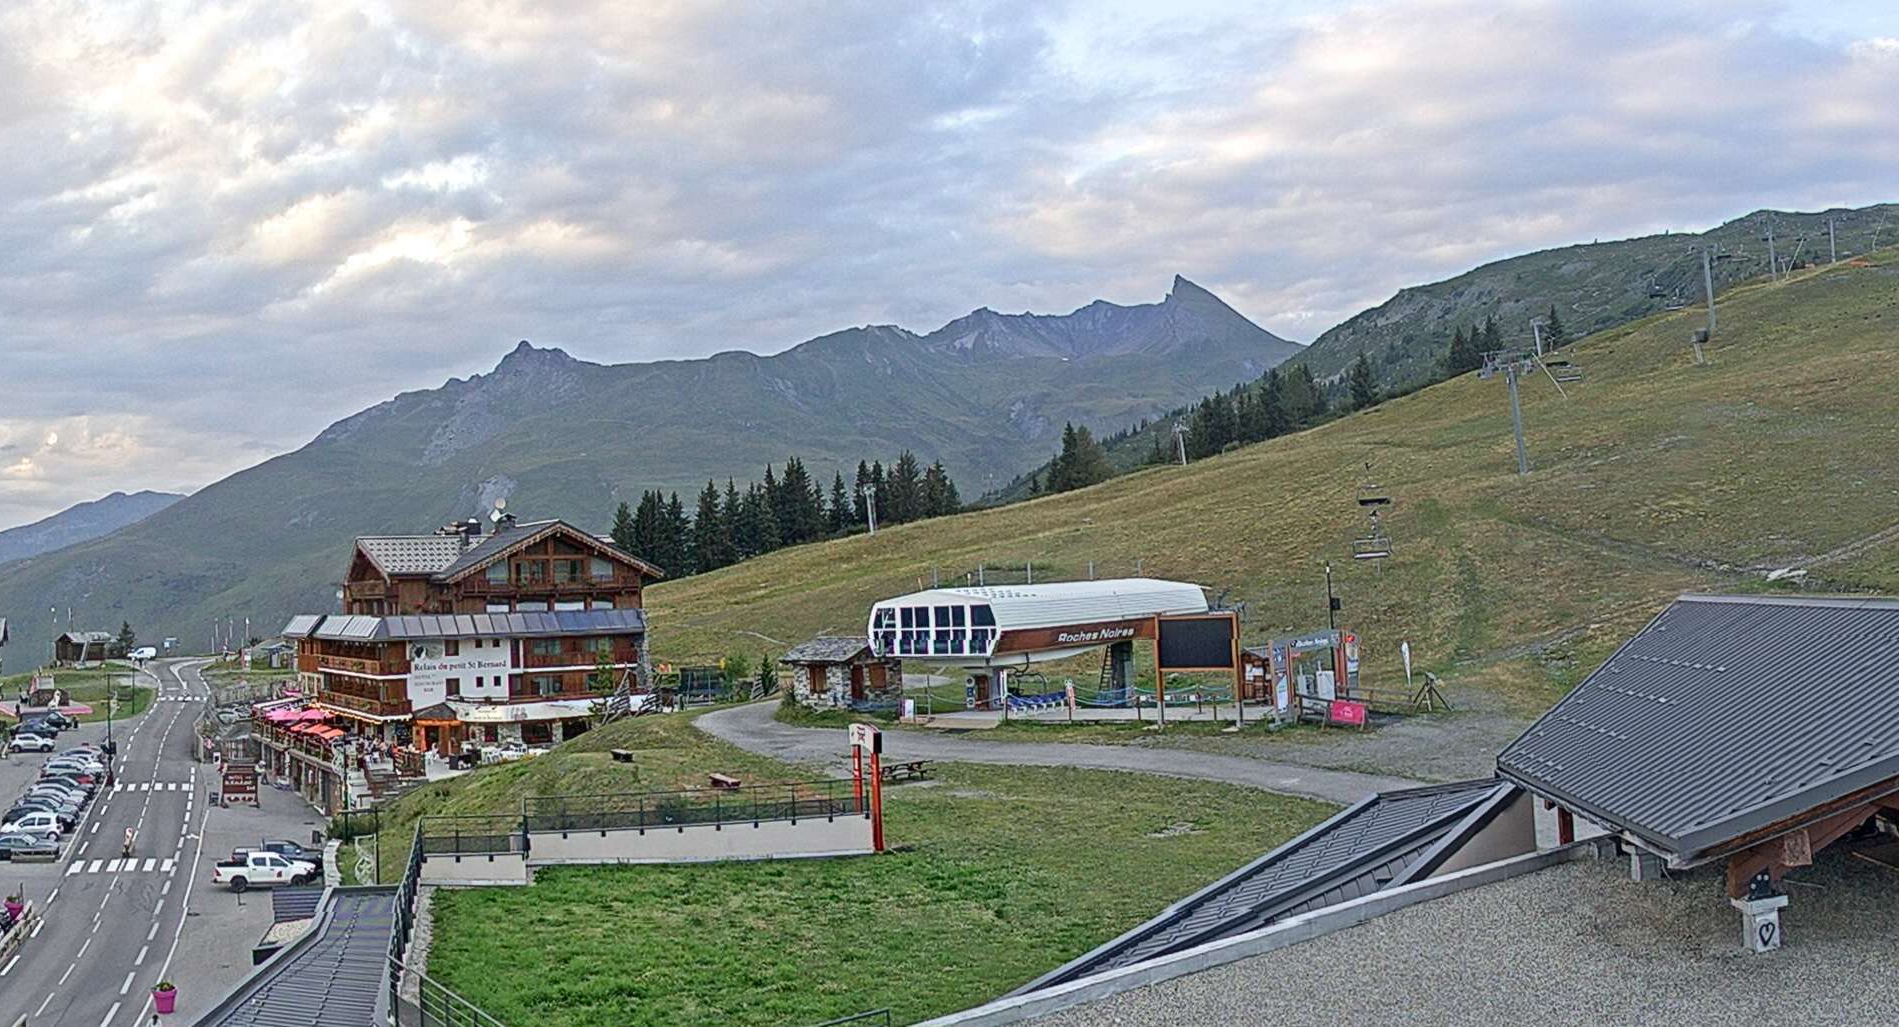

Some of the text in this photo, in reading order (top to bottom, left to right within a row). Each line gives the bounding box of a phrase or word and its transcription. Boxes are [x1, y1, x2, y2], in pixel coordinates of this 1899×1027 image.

[1058, 627, 1135, 642] Roches Noires
[414, 663, 436, 671] Relais
[477, 660, 506, 669] Bernard
